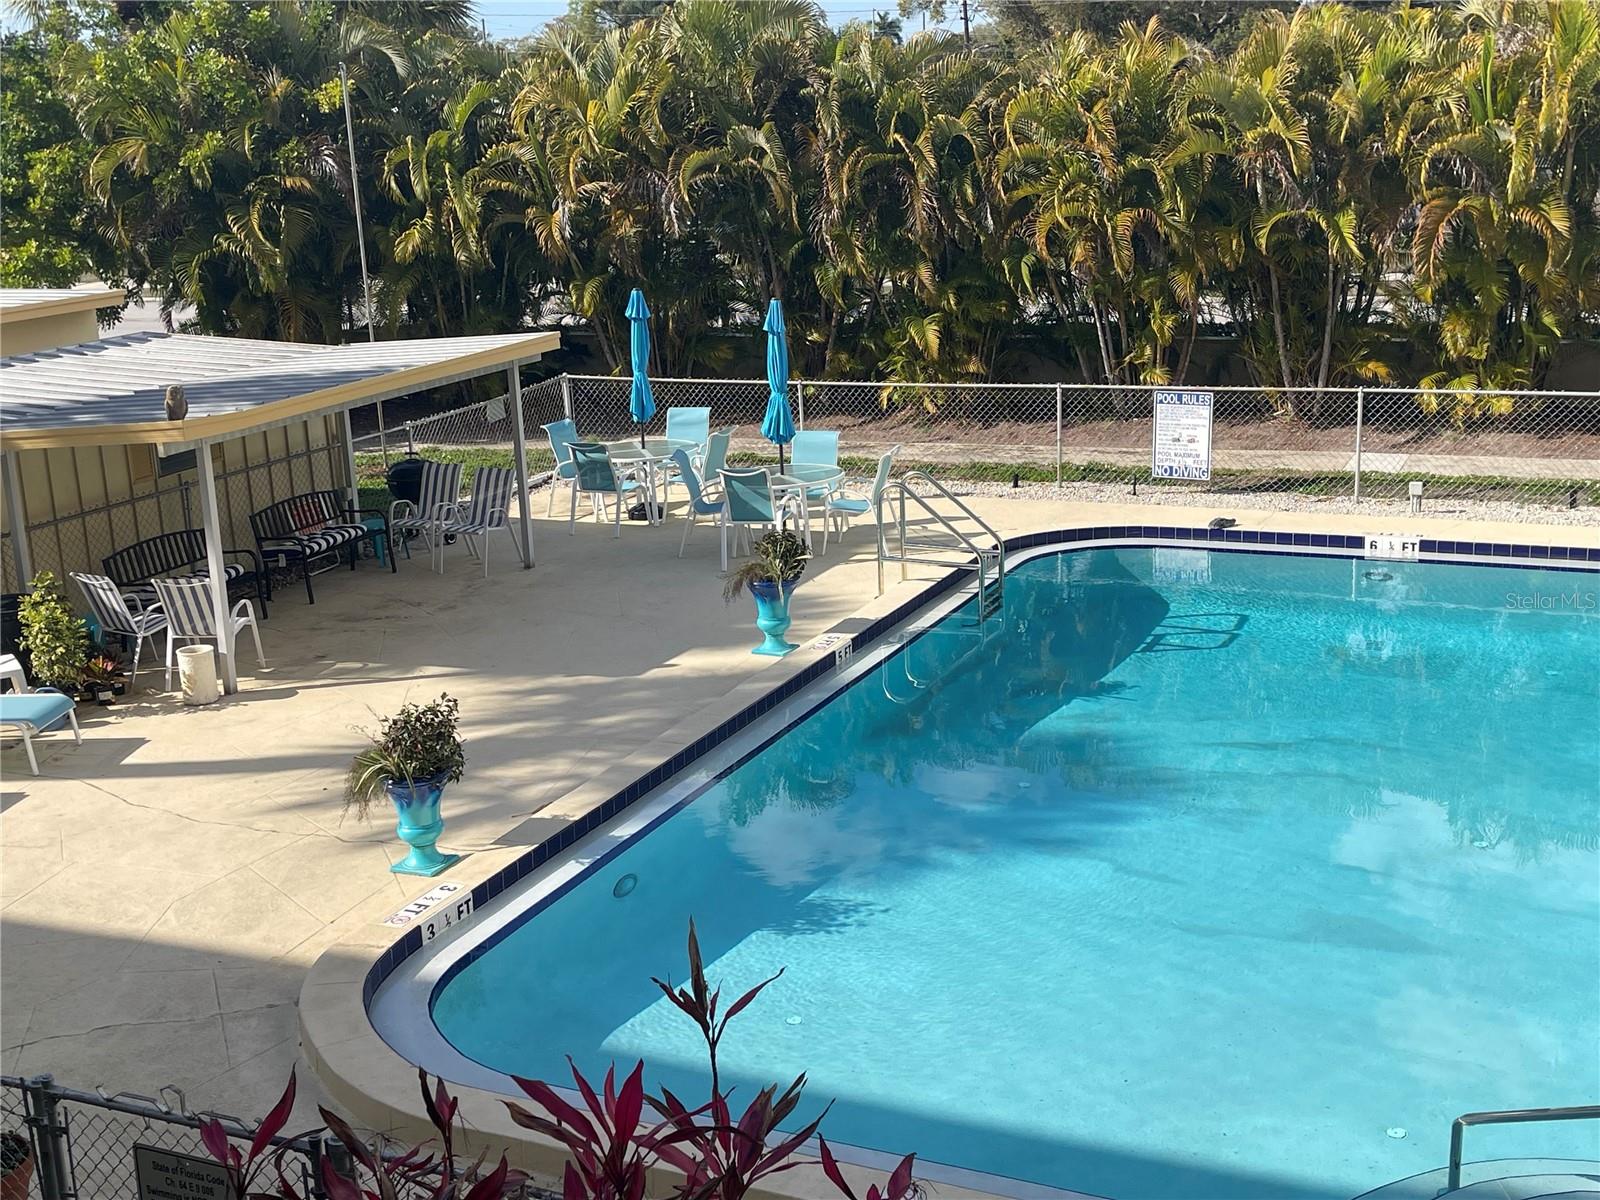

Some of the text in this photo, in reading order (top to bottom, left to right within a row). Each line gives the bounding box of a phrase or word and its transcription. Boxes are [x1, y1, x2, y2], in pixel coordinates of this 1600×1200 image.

[1157, 393, 1210, 405] POOL RULES
[1155, 465, 1208, 479] NO DIVING
[1370, 540, 1378, 550] 6
[1402, 542, 1417, 551] FT
[838, 644, 852, 661] 5 FT
[404, 903, 430, 916] FT
[426, 923, 436, 940] 3
[457, 898, 472, 920] FT
[152, 1160, 225, 1186] State of Florida Code
[146, 1184, 183, 1200] Swimming
[188, 1182, 195, 1192] E
